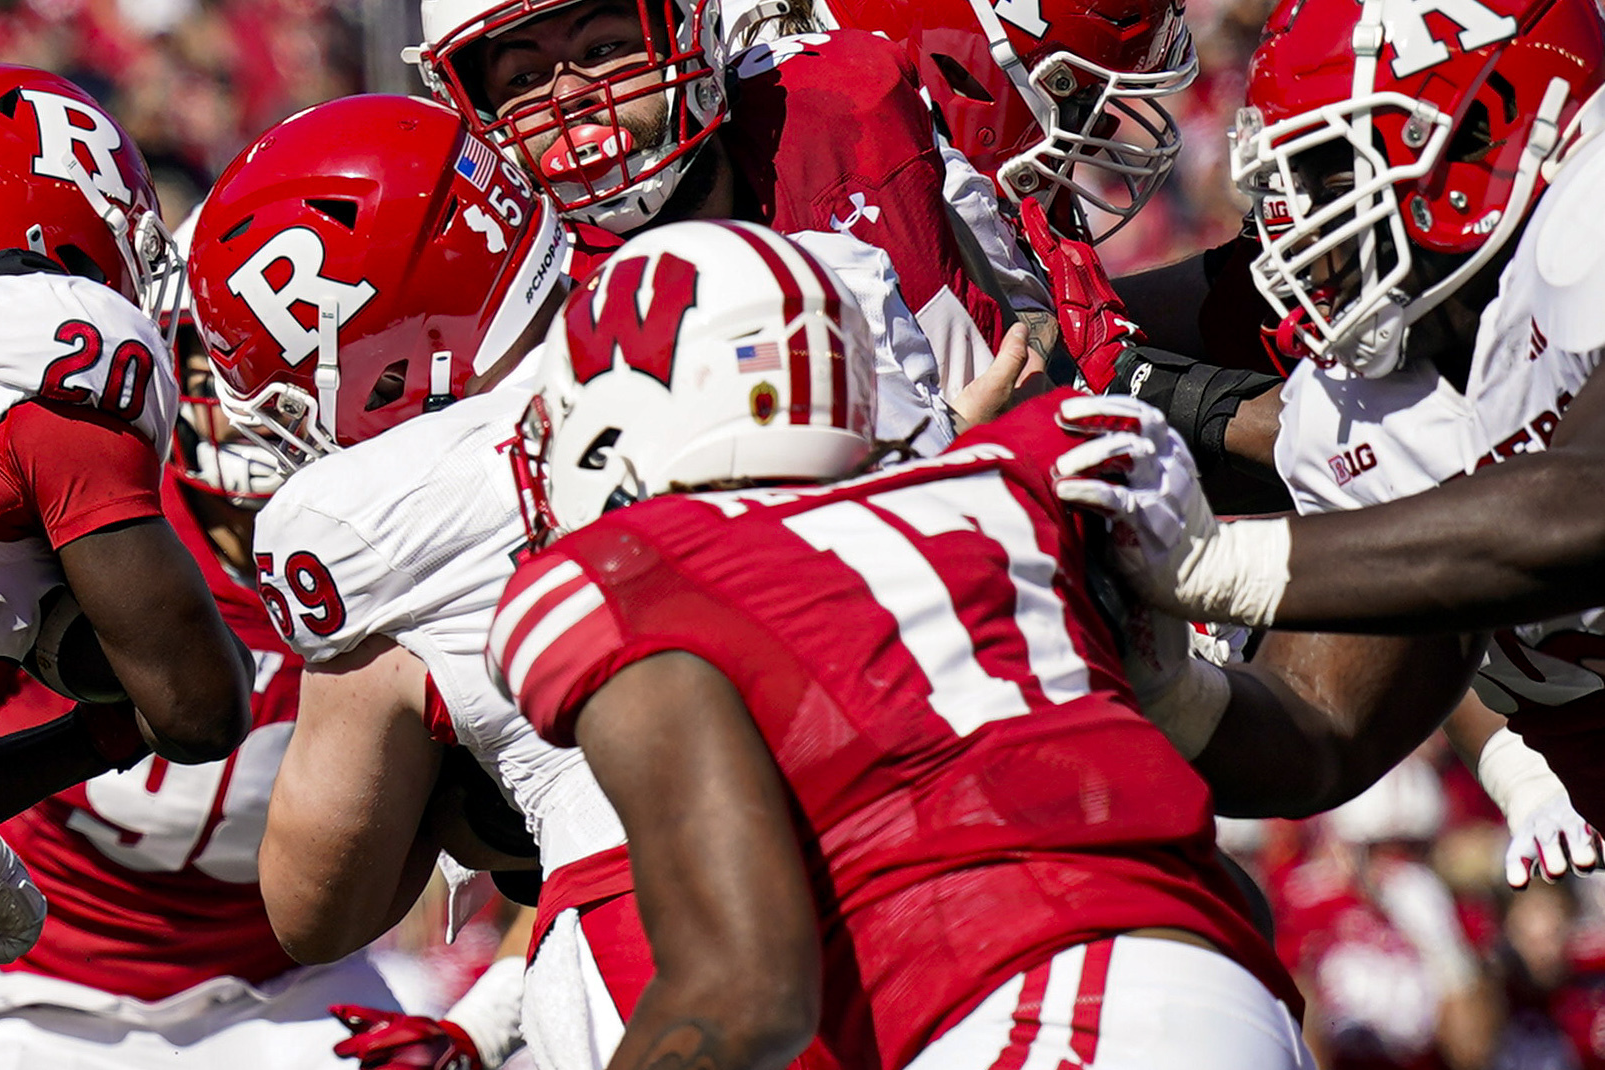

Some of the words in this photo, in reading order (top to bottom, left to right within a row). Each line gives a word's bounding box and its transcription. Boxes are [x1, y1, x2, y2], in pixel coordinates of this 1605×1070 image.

[20, 89, 133, 207] R
[488, 161, 532, 228] 59
[226, 226, 379, 368] R
[563, 250, 700, 393] W
[38, 318, 154, 422] 20
[254, 550, 348, 640] 59
[781, 468, 1092, 738] 17
